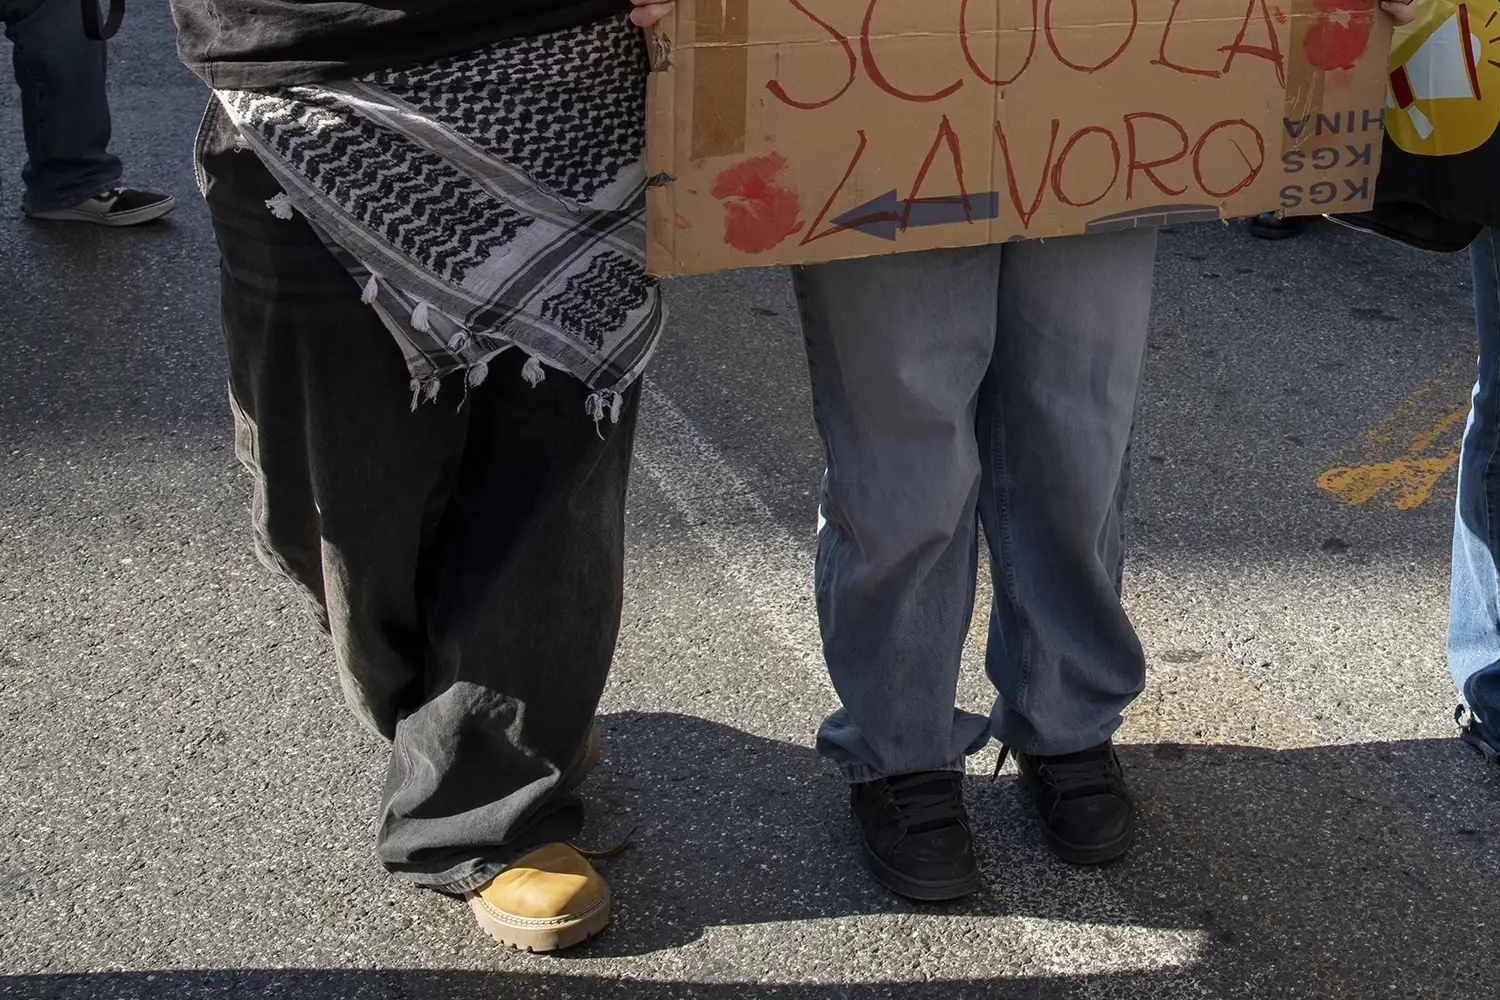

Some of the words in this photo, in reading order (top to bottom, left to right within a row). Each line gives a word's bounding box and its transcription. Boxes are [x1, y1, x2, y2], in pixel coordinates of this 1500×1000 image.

[1281, 143, 1371, 173] KGS
[799, 112, 1265, 246] LAVORO
[1279, 177, 1369, 208] KGS
